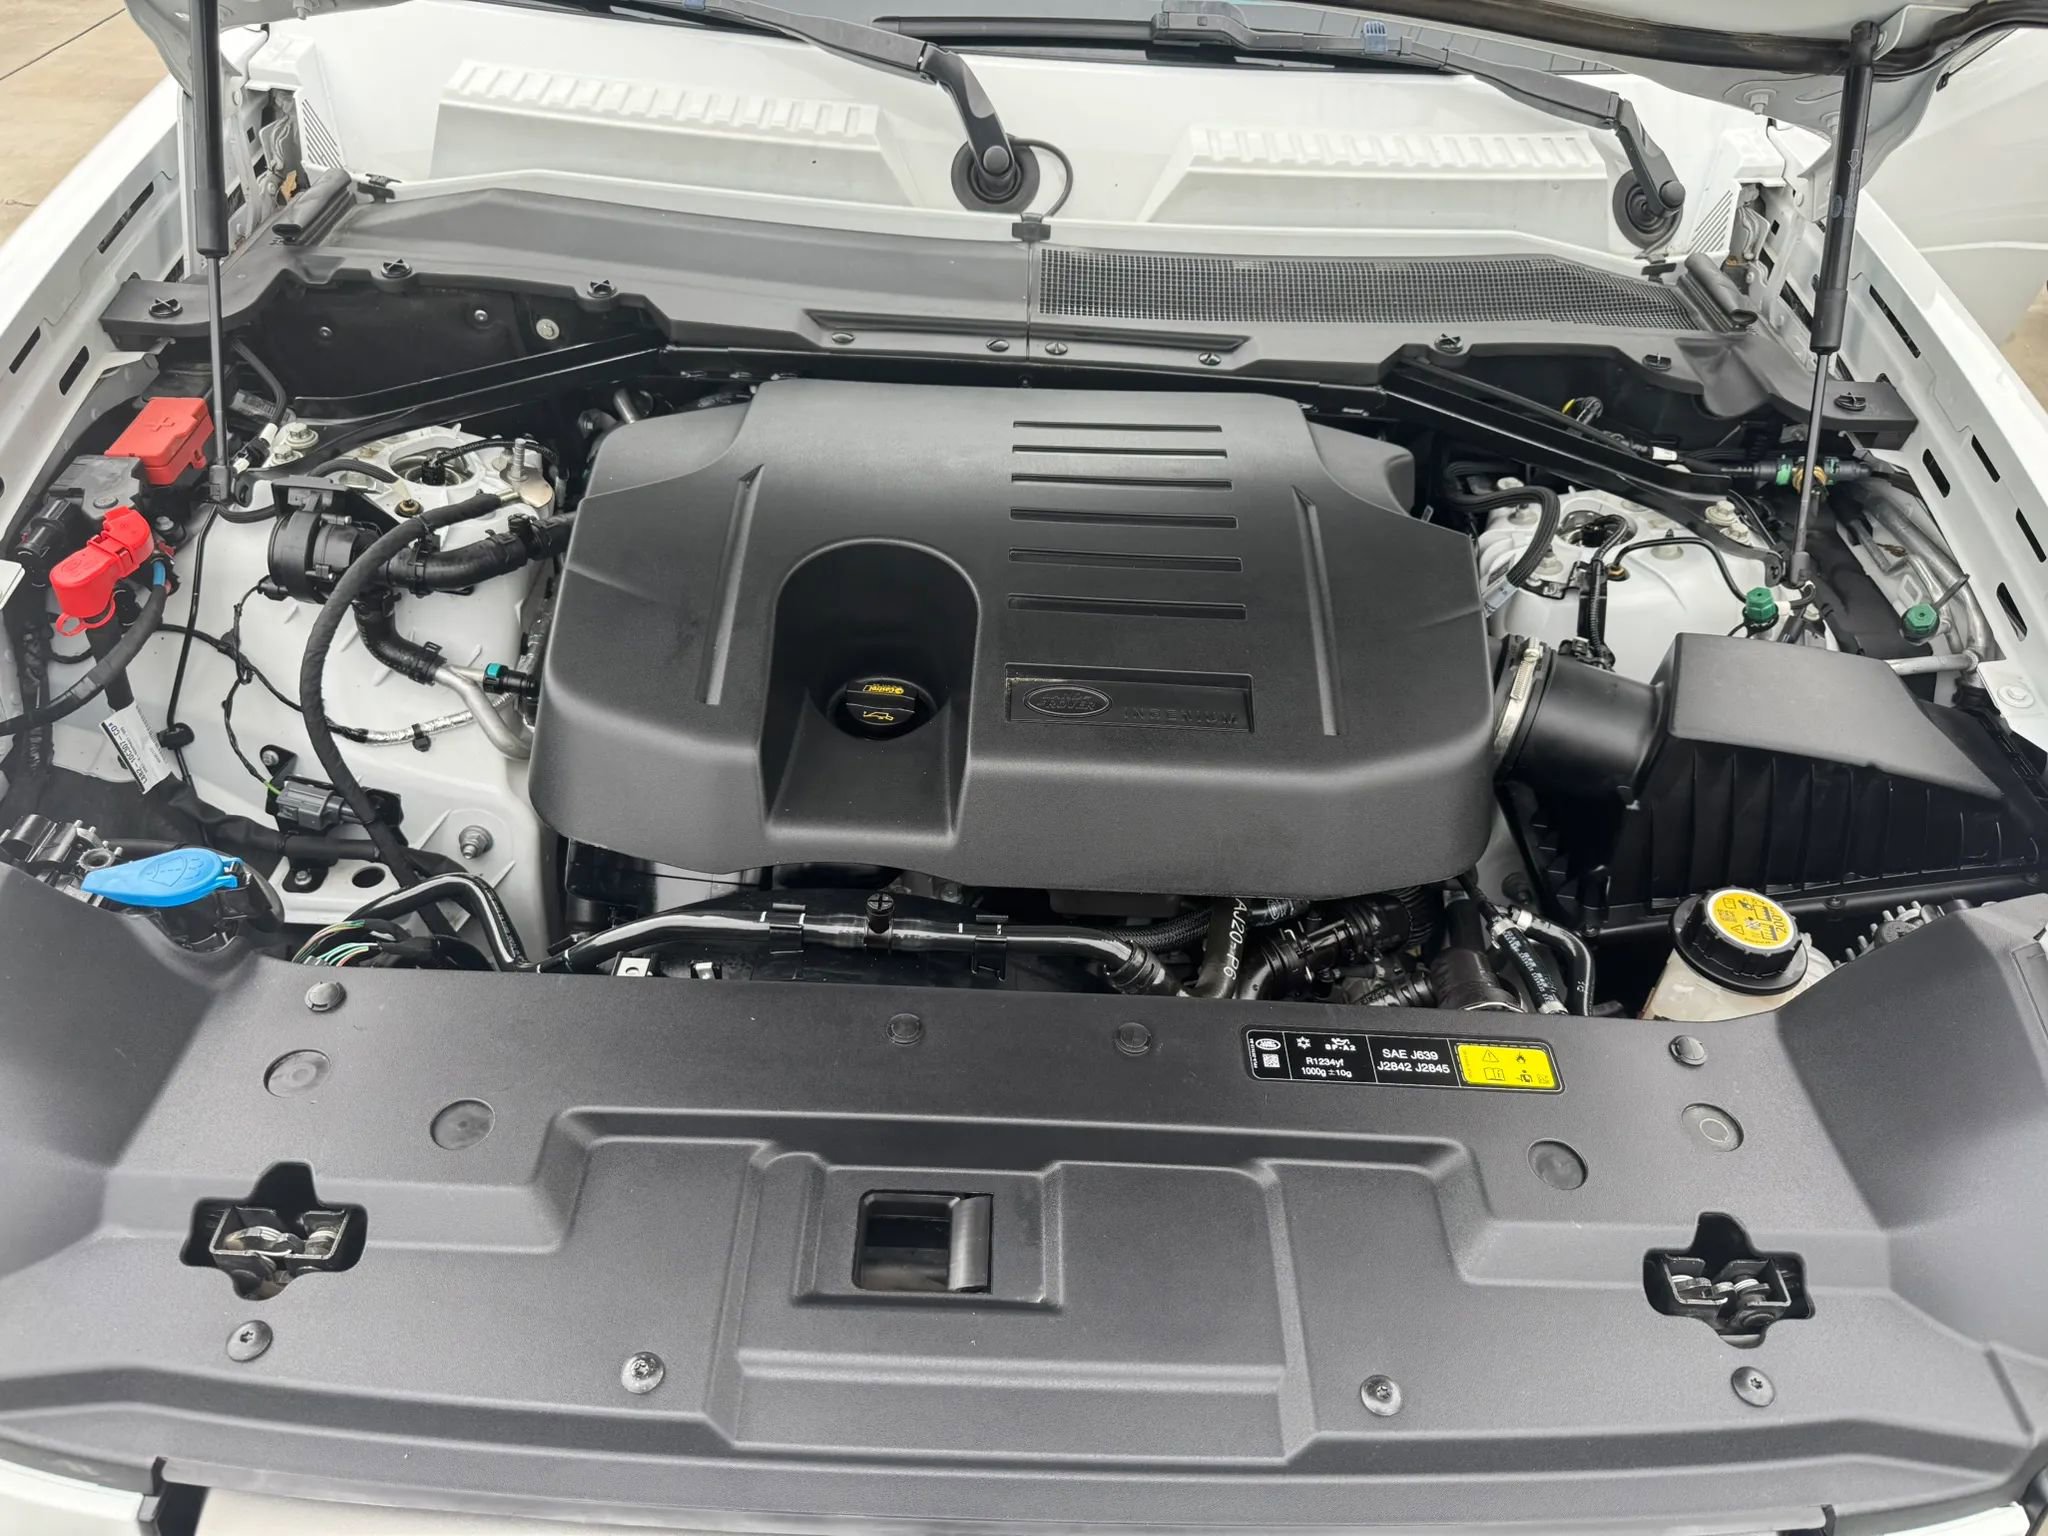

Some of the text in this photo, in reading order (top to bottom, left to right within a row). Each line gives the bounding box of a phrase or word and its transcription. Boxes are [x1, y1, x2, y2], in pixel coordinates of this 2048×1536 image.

[1382, 1048, 1439, 1060] SAE J639
[1301, 1066, 1327, 1078] 1000g
[1377, 1061, 1450, 1073] J2842 J2845
